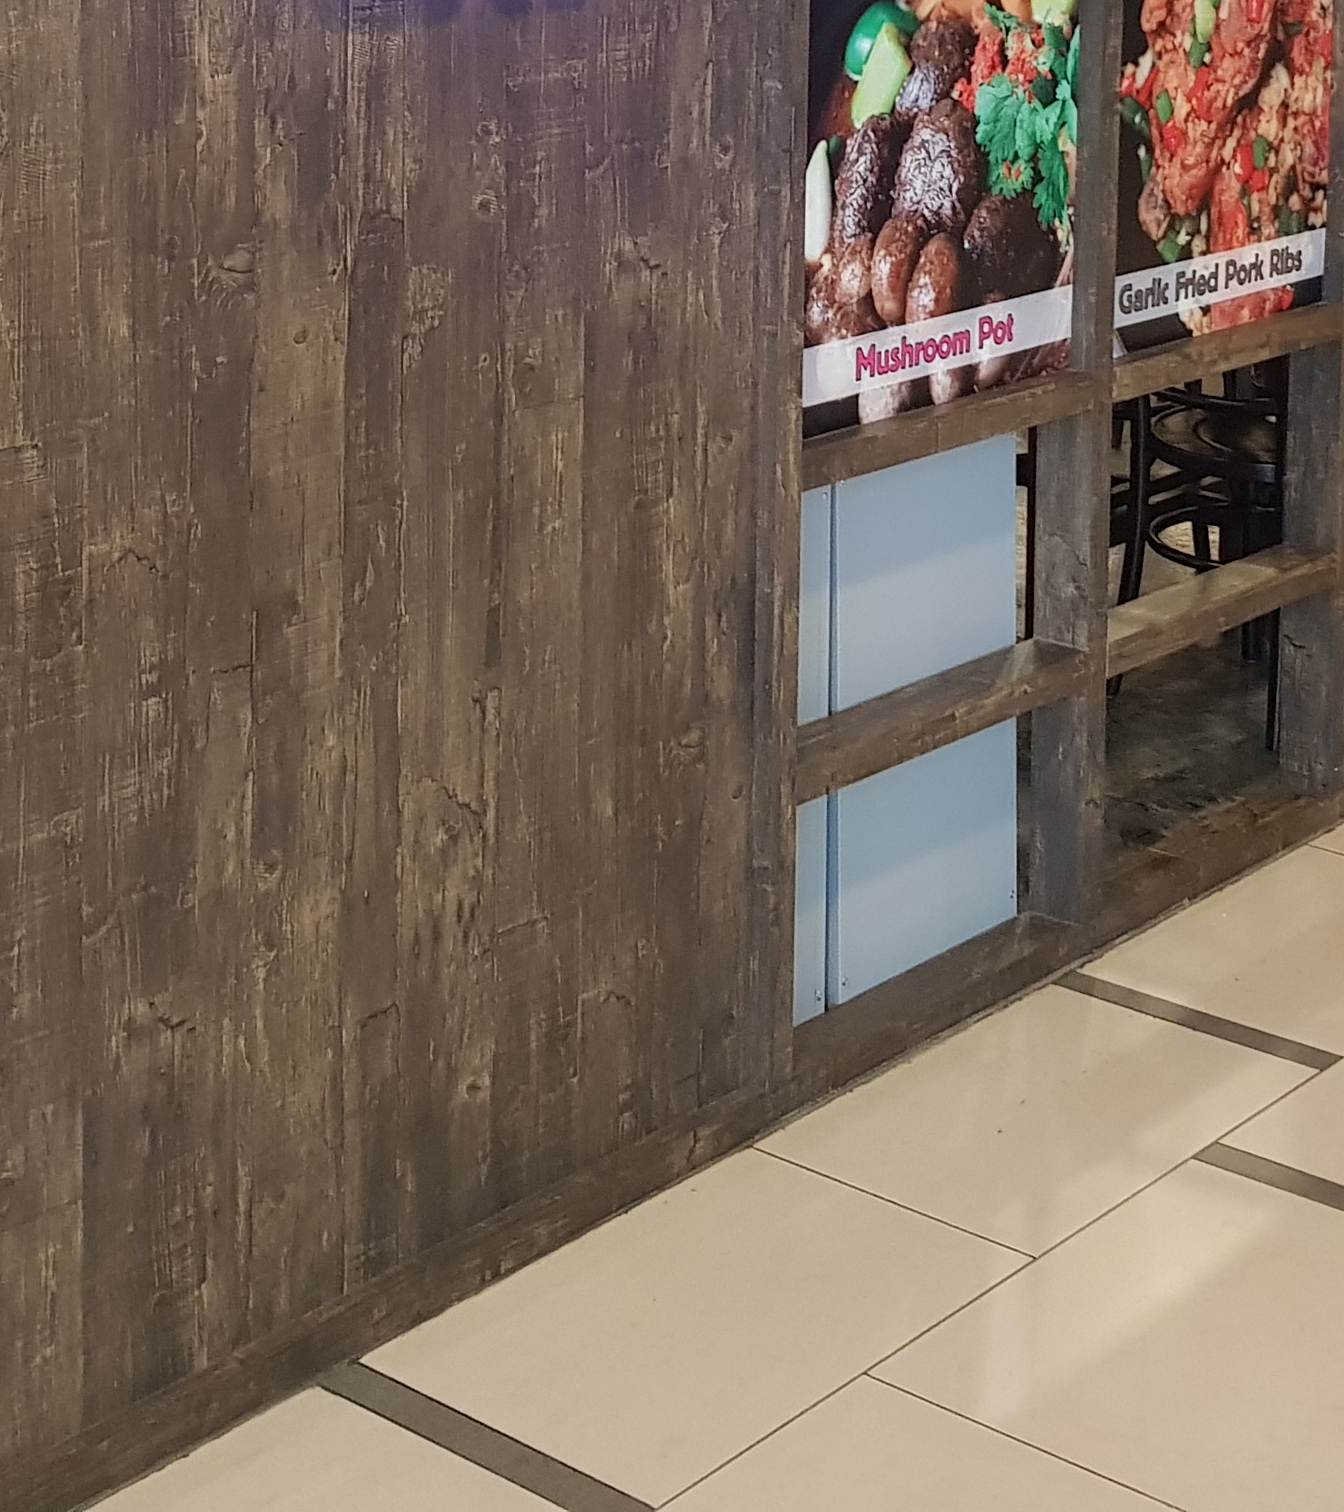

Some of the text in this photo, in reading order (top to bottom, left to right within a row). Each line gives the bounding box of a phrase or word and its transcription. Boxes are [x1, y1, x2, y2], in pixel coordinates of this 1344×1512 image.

[1118, 244, 1303, 315] Garlic Fried Pork Ribs
[855, 312, 1015, 383] Mushroom Pot
